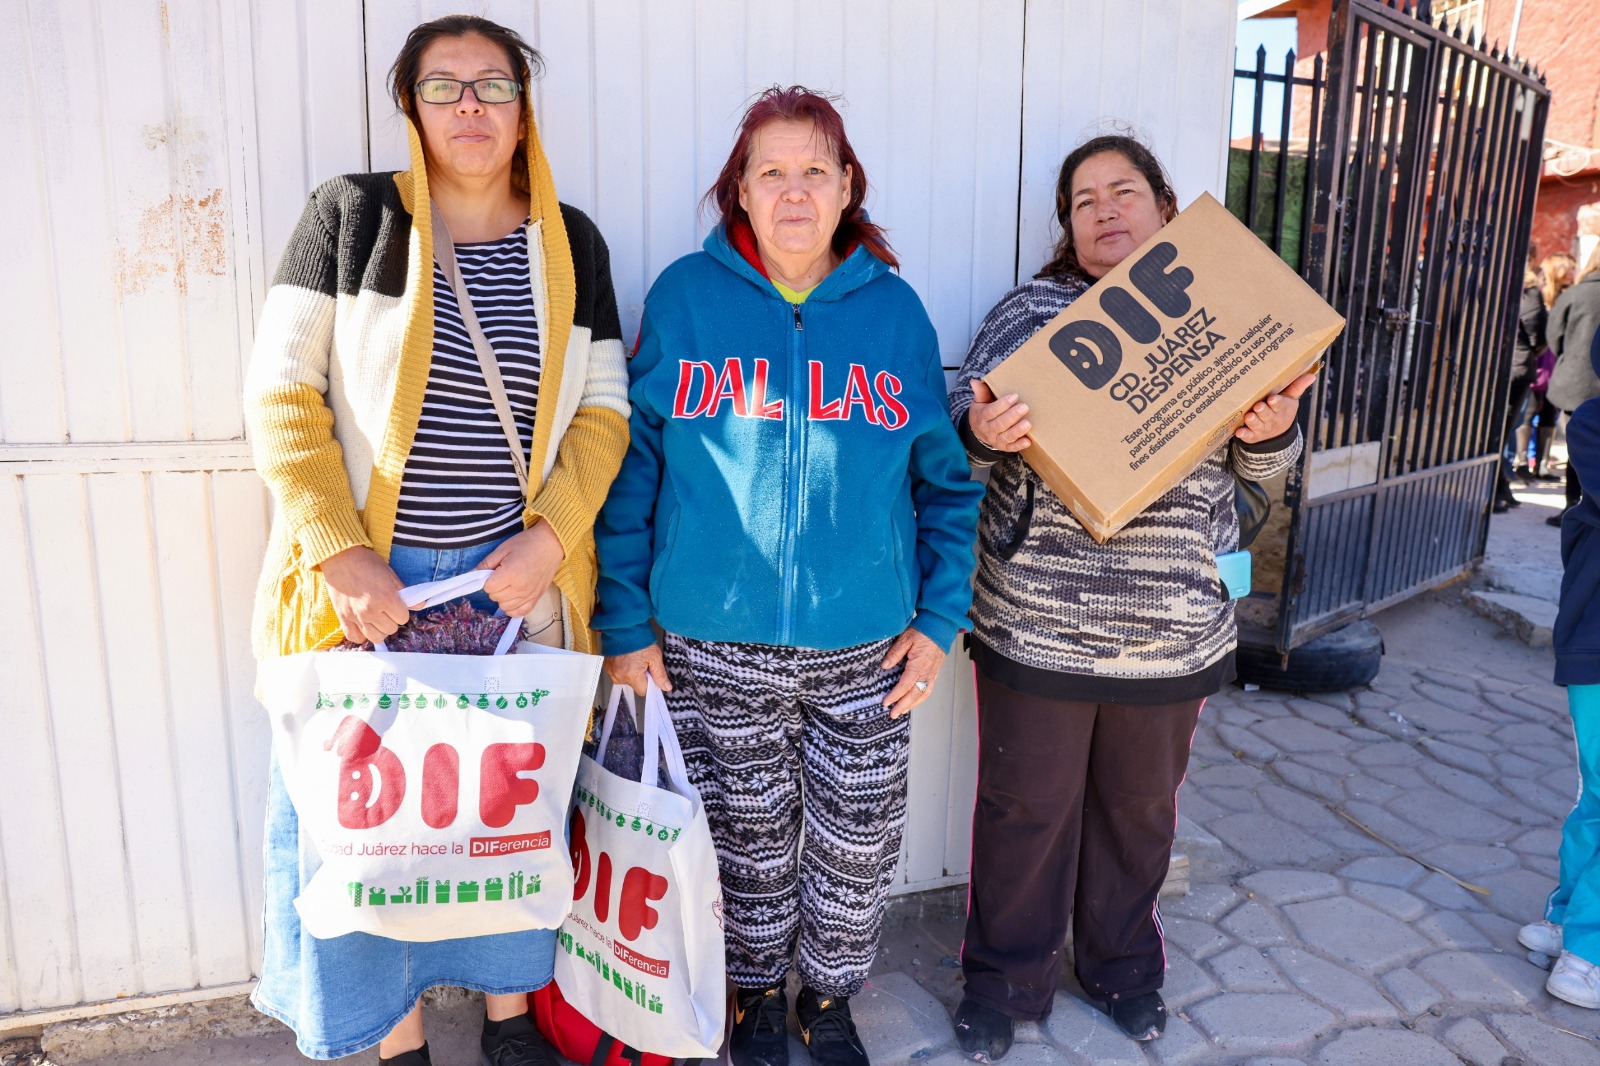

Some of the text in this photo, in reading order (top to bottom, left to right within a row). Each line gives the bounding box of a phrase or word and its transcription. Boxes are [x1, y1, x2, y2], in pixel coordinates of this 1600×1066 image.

[1048, 241, 1195, 391] DIF
[1109, 306, 1217, 402] CD. JUÁREZ
[1126, 330, 1227, 415] DESPENSA
[1141, 398, 1178, 432] programa
[1176, 389, 1187, 400] es
[1185, 365, 1216, 393] público,
[1213, 347, 1235, 367] ajeno
[1233, 342, 1241, 350] a
[1239, 313, 1273, 345] cualquier
[1239, 364, 1252, 376] en
[1250, 355, 1260, 366] el
[1129, 432, 1156, 458] partido
[1154, 408, 1185, 436] político.
[1182, 385, 1209, 409] Queda
[1207, 356, 1243, 390] prohibido
[1241, 347, 1253, 358] su
[1251, 336, 1266, 349] uso
[1264, 321, 1283, 340] para
[1195, 373, 1241, 414] establecidos
[1177, 422, 1186, 430] a
[1181, 411, 1197, 425] los
[1148, 427, 1180, 455] distintos
[1129, 453, 1150, 471] fines
[337, 742, 546, 830] DIF
[357, 841, 407, 857] Juárez
[411, 841, 447, 856] hace
[451, 842, 464, 856] la
[472, 834, 549, 855] DIFerencia
[589, 923, 605, 943] hace
[605, 936, 613, 949] la
[614, 943, 668, 976] DIFerencia
